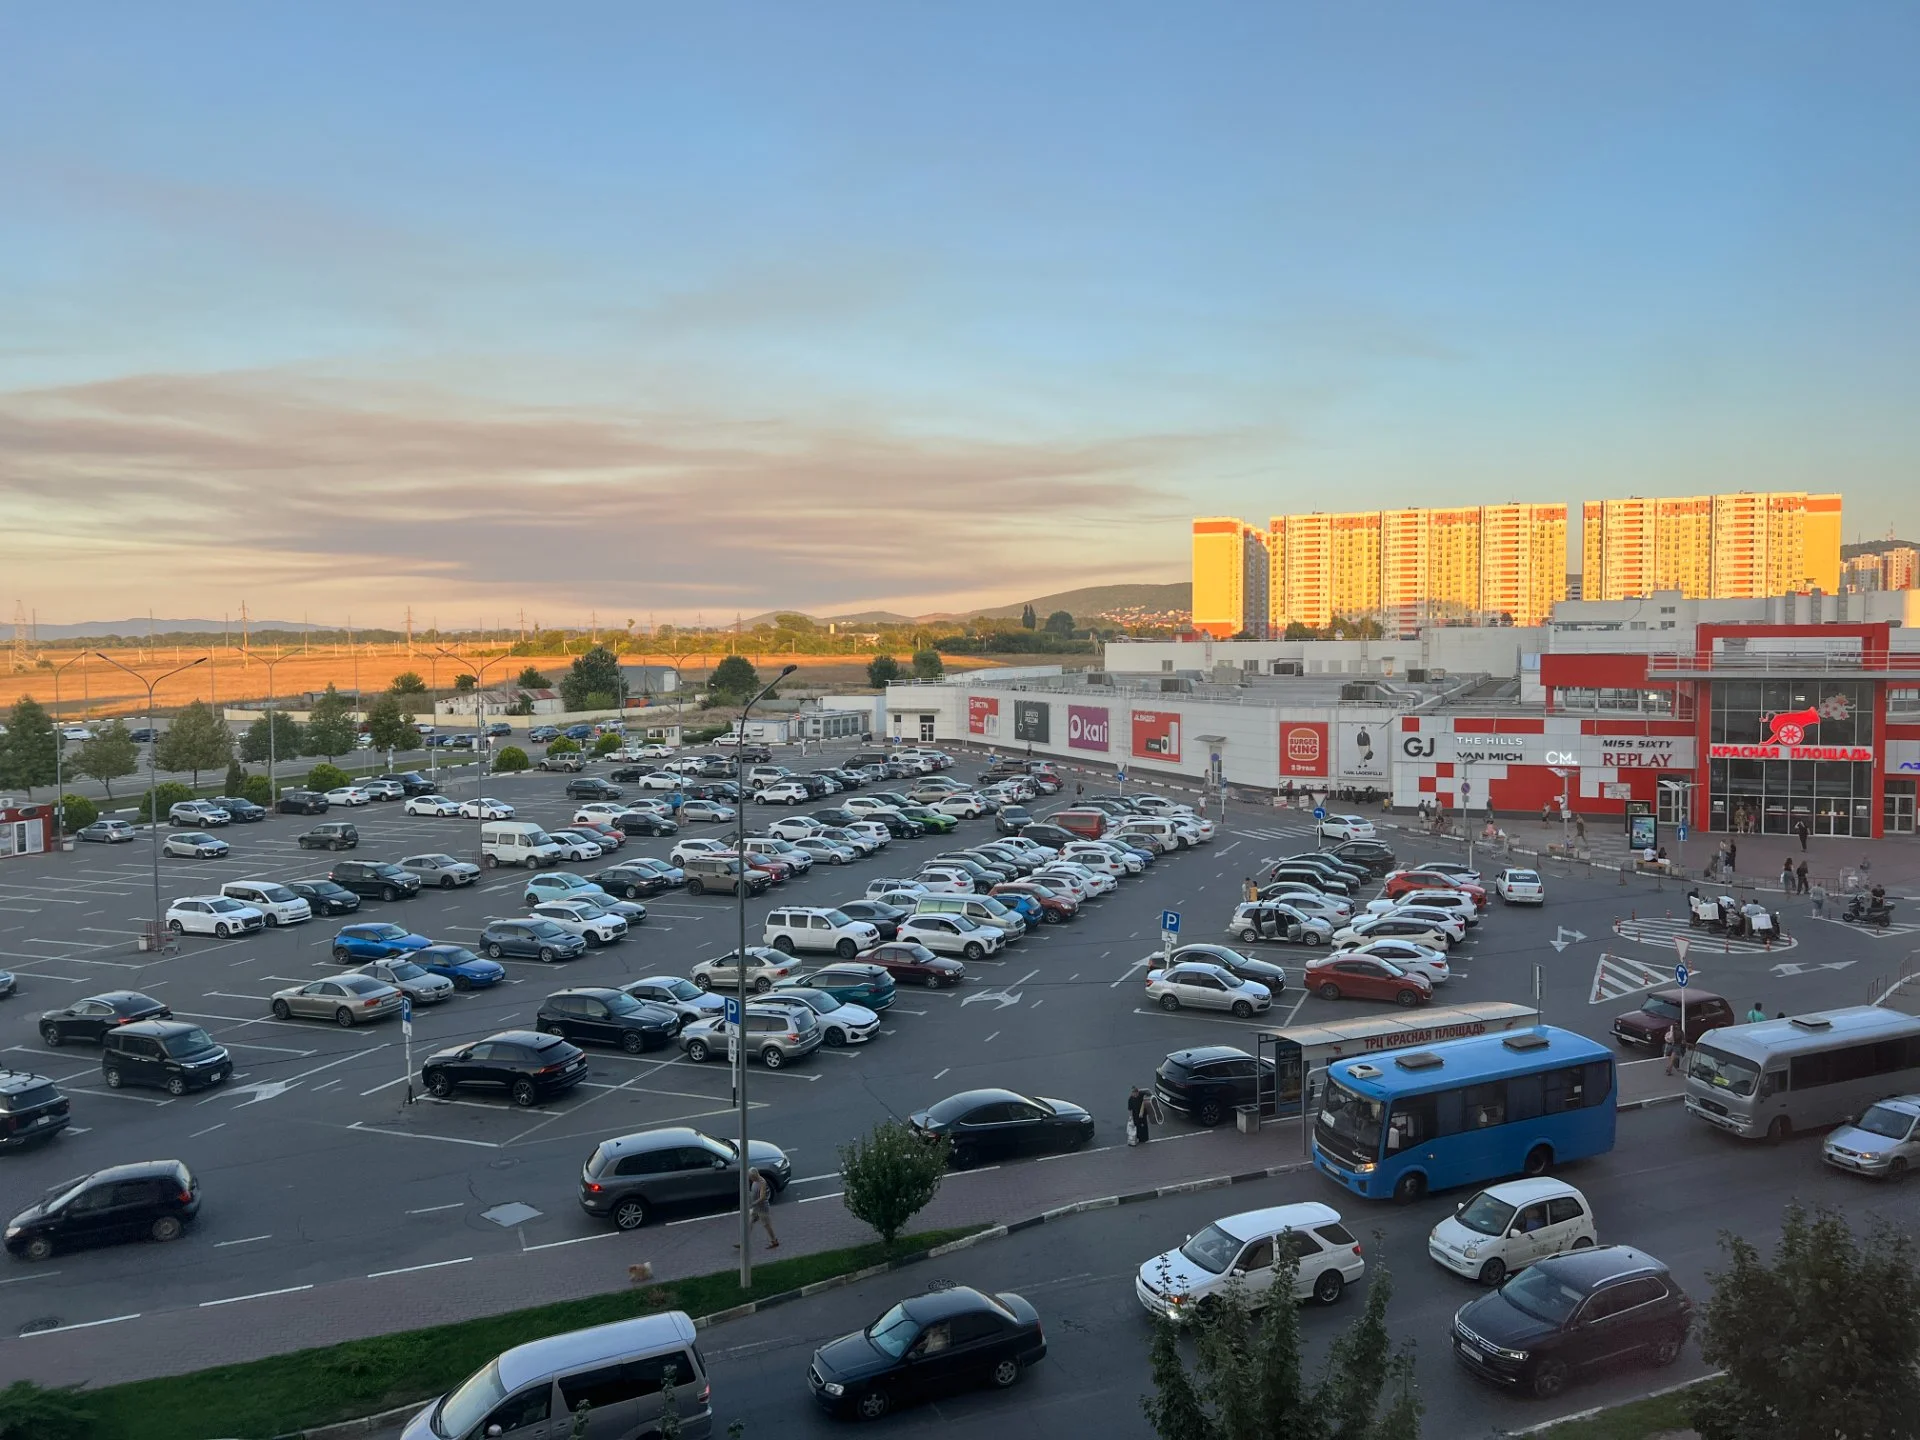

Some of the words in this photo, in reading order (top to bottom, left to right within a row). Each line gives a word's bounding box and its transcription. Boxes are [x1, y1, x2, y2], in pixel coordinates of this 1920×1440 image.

[1083, 718, 1108, 743] kari
[1290, 745, 1317, 754] KING
[1403, 737, 1435, 757] GJ
[1602, 740, 1633, 748] MISS
[1637, 741, 1673, 749] SIXTY
[1457, 751, 1485, 760] VAN
[1488, 752, 1523, 761] MICH
[1602, 752, 1673, 767] REPLAY
[1711, 746, 1779, 758] КРАСНАЯ
[1790, 748, 1872, 761] ПЛОЩАДЬ
[1166, 913, 1177, 929] P
[404, 999, 410, 1020] P
[728, 1000, 737, 1021] P
[1364, 1038, 1384, 1049] ТРЦ
[1386, 1031, 1432, 1046] КРАСНАЯ
[1435, 1023, 1486, 1039] ПЛОЩАДЬ
